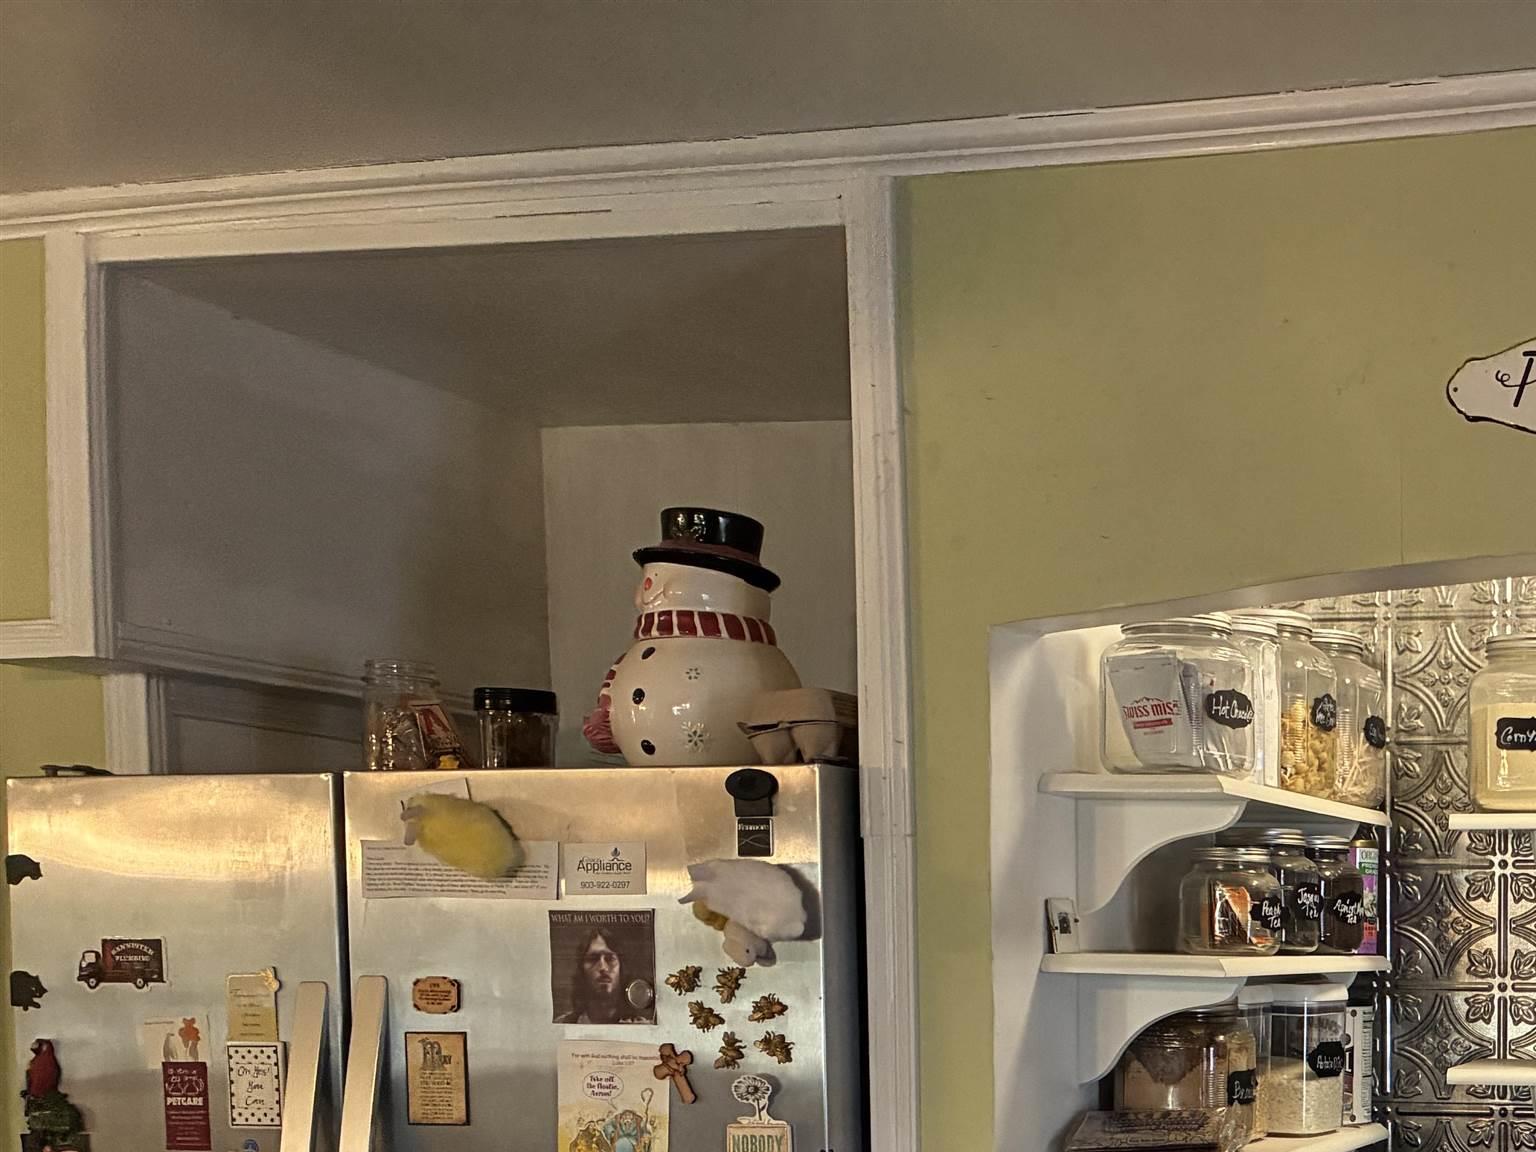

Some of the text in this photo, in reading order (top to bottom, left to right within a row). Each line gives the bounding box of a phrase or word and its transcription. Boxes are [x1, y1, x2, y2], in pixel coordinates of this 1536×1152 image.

[577, 859, 633, 873] Appliance
[551, 912, 573, 924] WHAT
[589, 914, 618, 924] WORTH
[618, 914, 630, 924] TO
[166, 1096, 204, 1106] PETCARE
